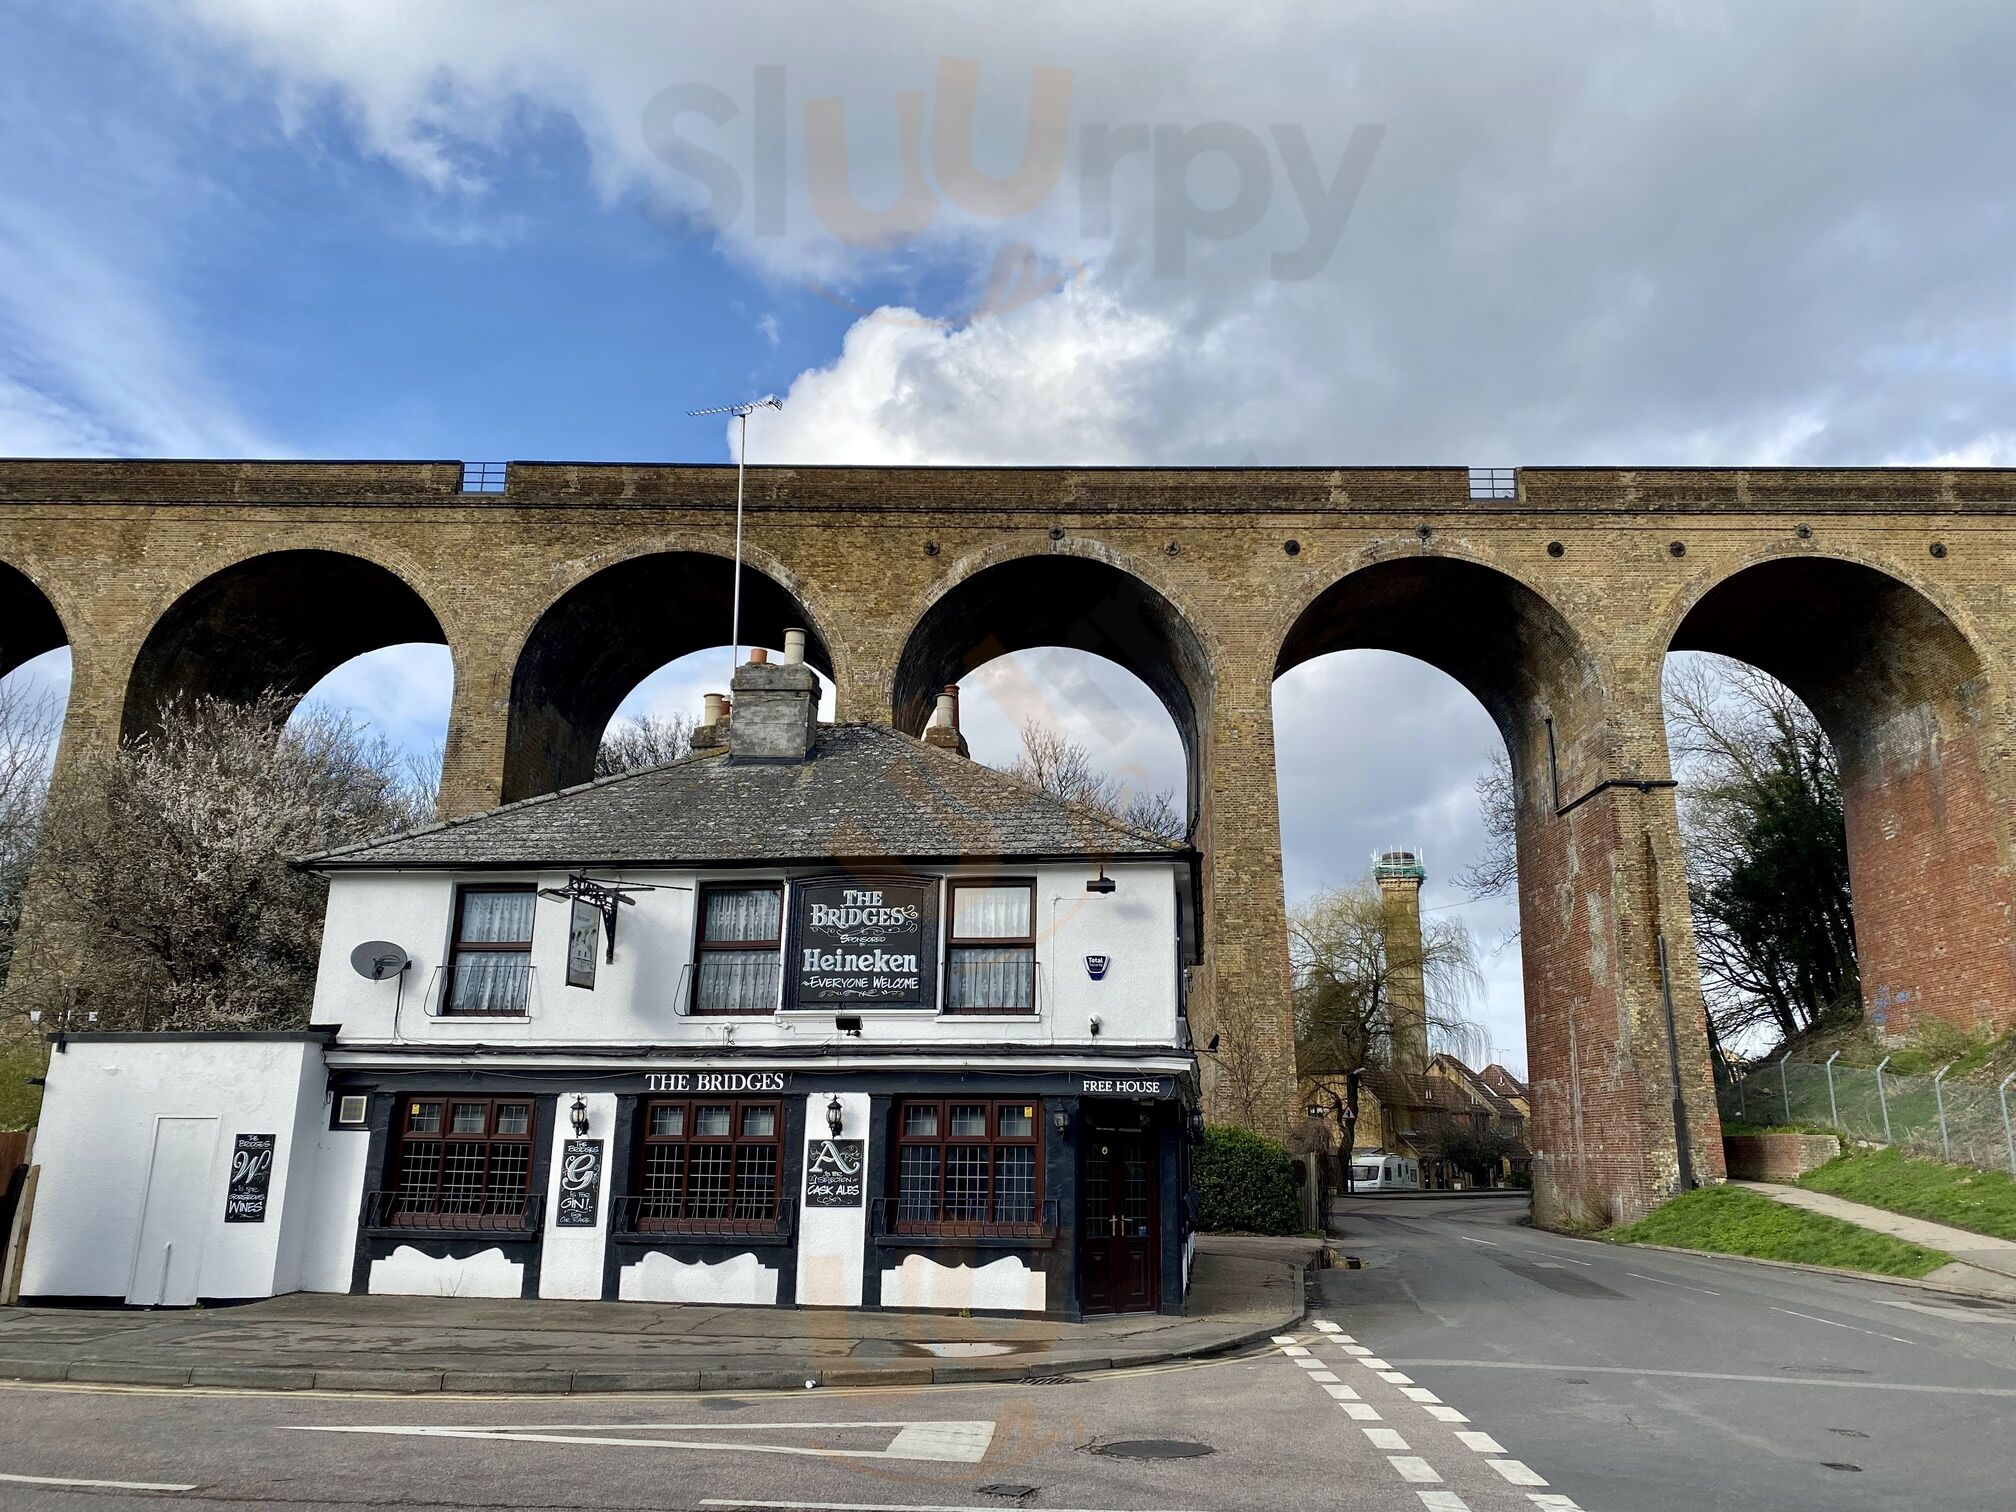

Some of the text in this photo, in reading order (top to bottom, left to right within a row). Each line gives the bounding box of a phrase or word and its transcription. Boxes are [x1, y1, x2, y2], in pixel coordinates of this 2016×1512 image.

[843, 889, 883, 907] THE
[810, 903, 906, 930] BRIDGES
[839, 934, 886, 944] SPONSORED
[802, 948, 918, 973] Heineken
[873, 975, 919, 989] WELCOME
[645, 1073, 784, 1091] THE BRIDGES
[1083, 1080, 1160, 1093] FREE HOUSE
[808, 1141, 861, 1174] A
[807, 1184, 860, 1196] CASK ALES
[228, 1200, 263, 1214] WINES
